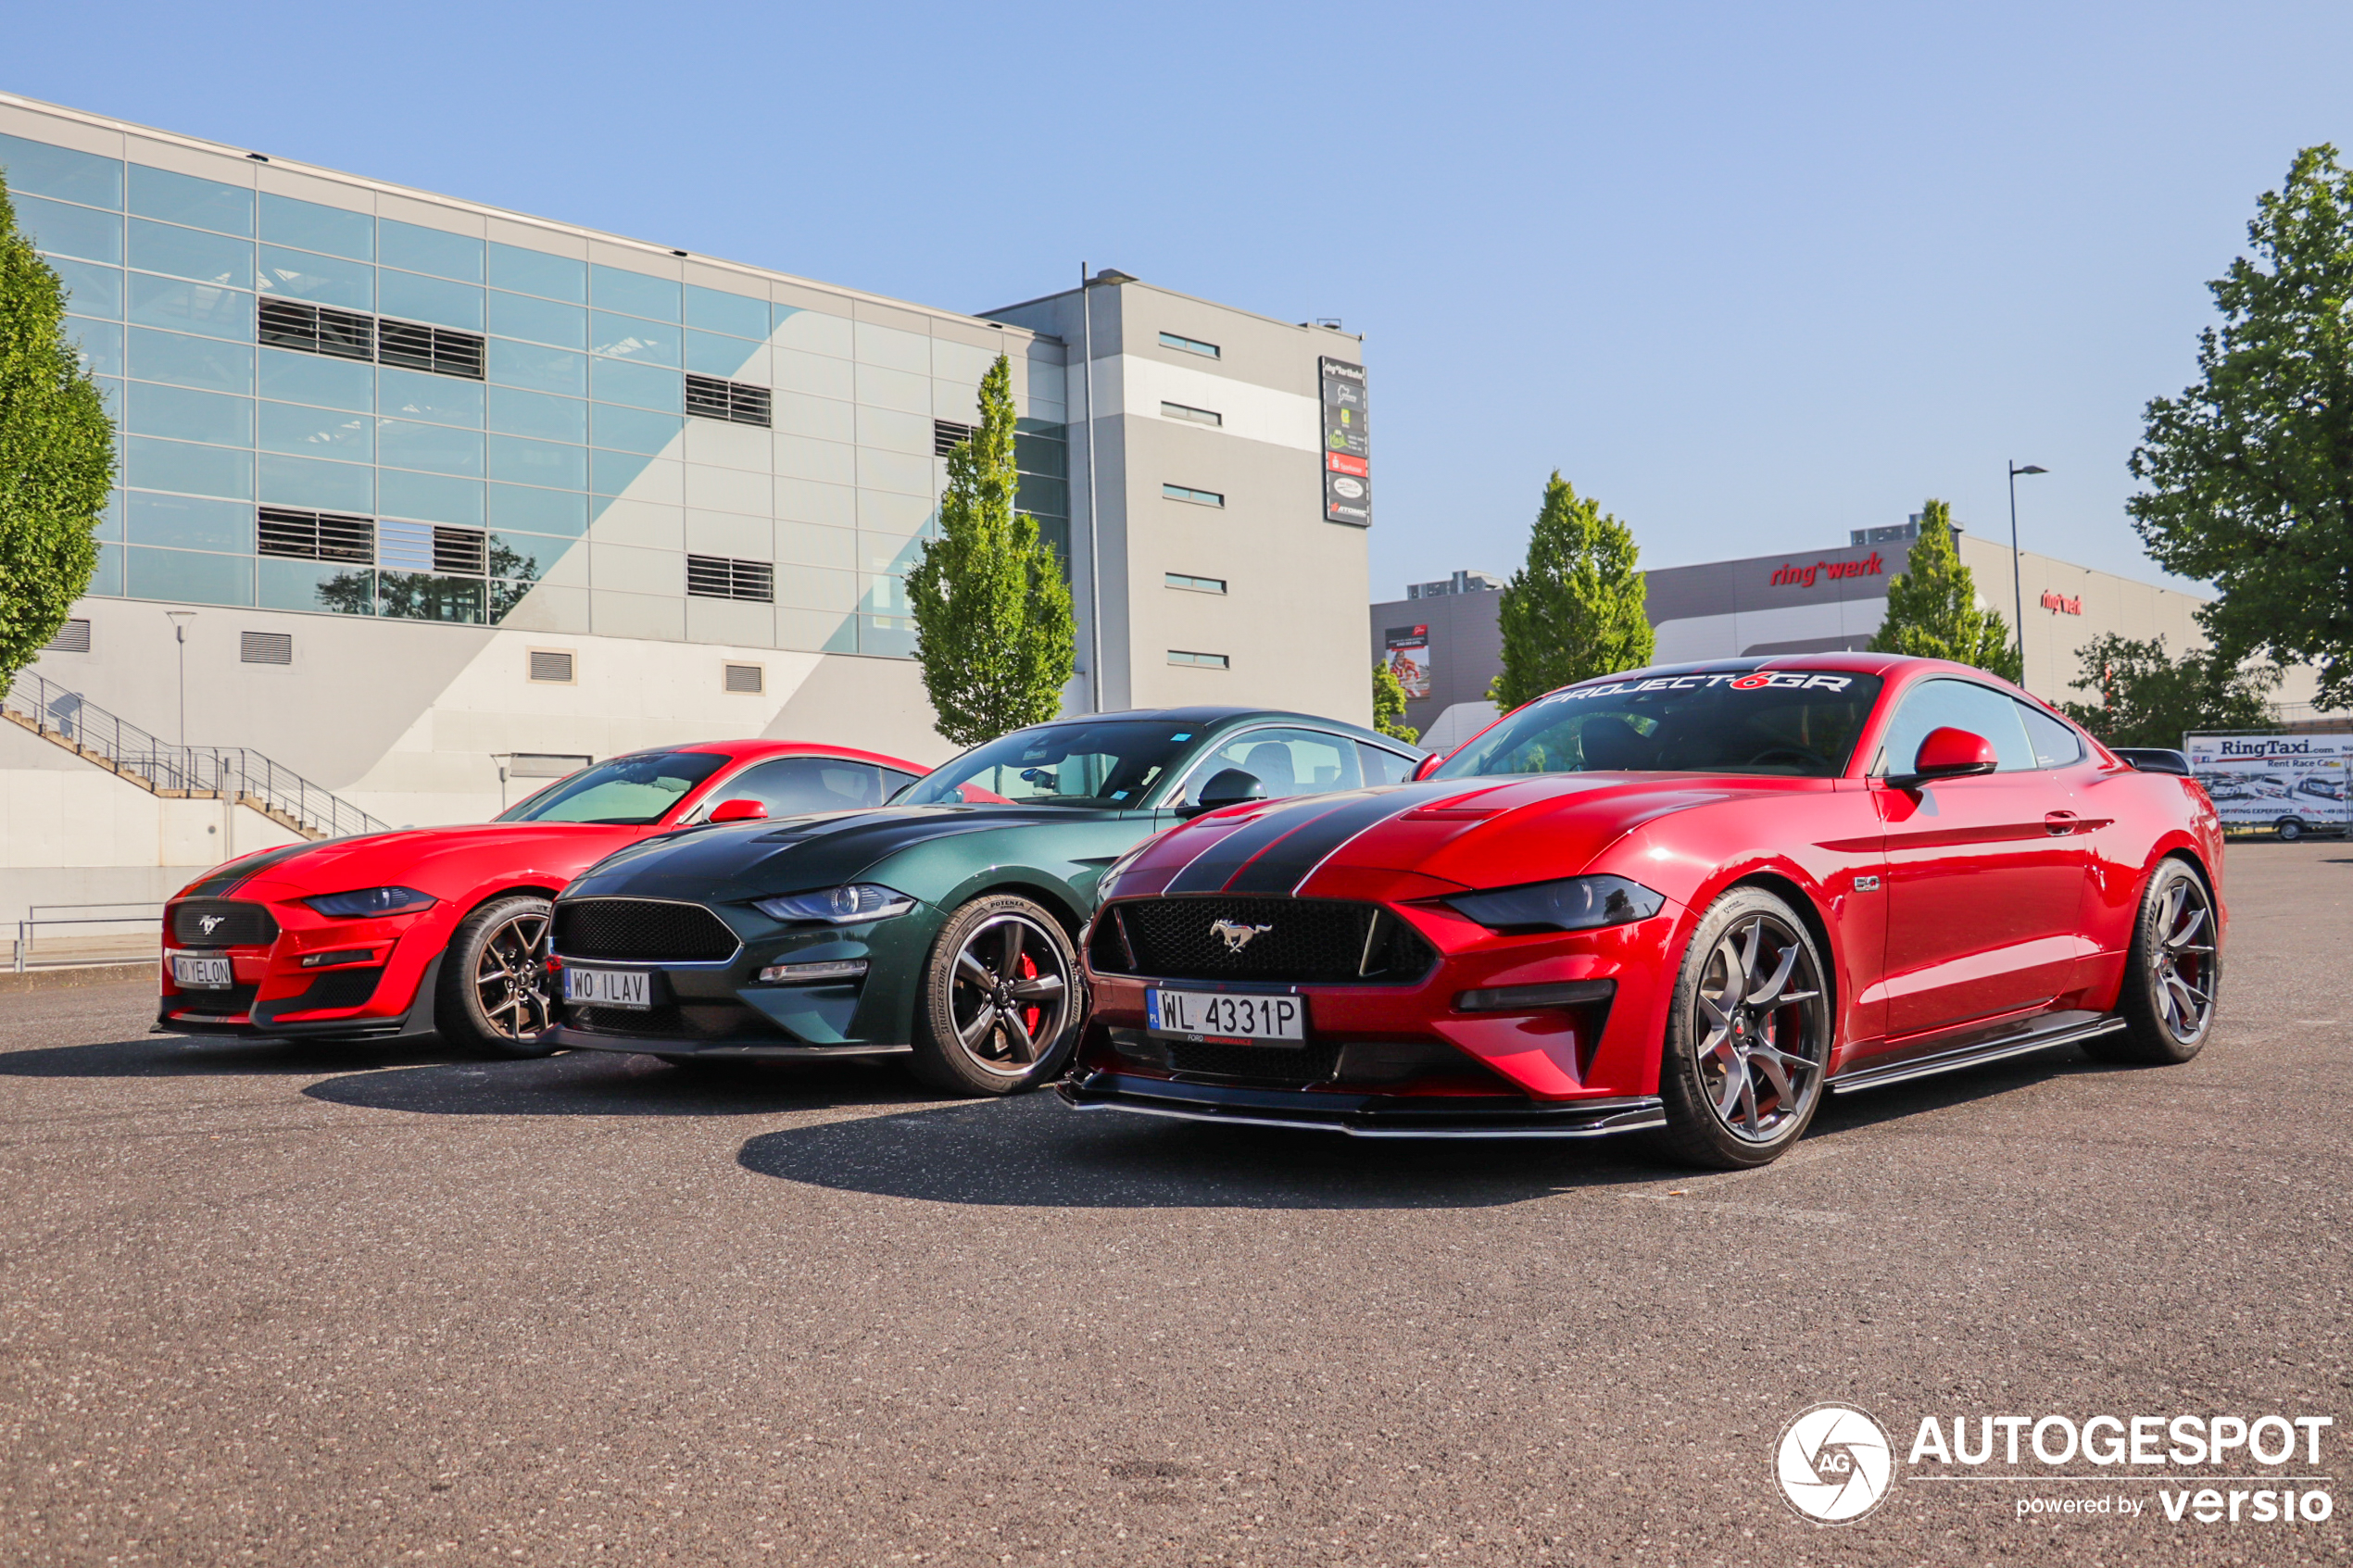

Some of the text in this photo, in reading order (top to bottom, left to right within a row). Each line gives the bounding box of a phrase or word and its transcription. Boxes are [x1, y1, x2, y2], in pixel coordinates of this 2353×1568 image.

[1340, 462, 1362, 473] Sparkasse
[1338, 505, 1367, 517] ATOMIC
[1770, 551, 1883, 587] ring°werk
[2041, 589, 2082, 616] ring°werk
[2221, 739, 2334, 758] RingTaxi.com
[2268, 759, 2290, 768] Rent
[2293, 759, 2315, 768] Race
[990, 900, 1025, 909] POTENZA
[190, 961, 229, 982] YELON
[604, 973, 642, 1002] ILAV
[937, 963, 950, 1035] BRIDGESTONE
[1150, 1013, 1158, 1023] PL
[1162, 994, 1295, 1035] WL 4331P
[1188, 1034, 1252, 1046] FORD PERFORMANCE
